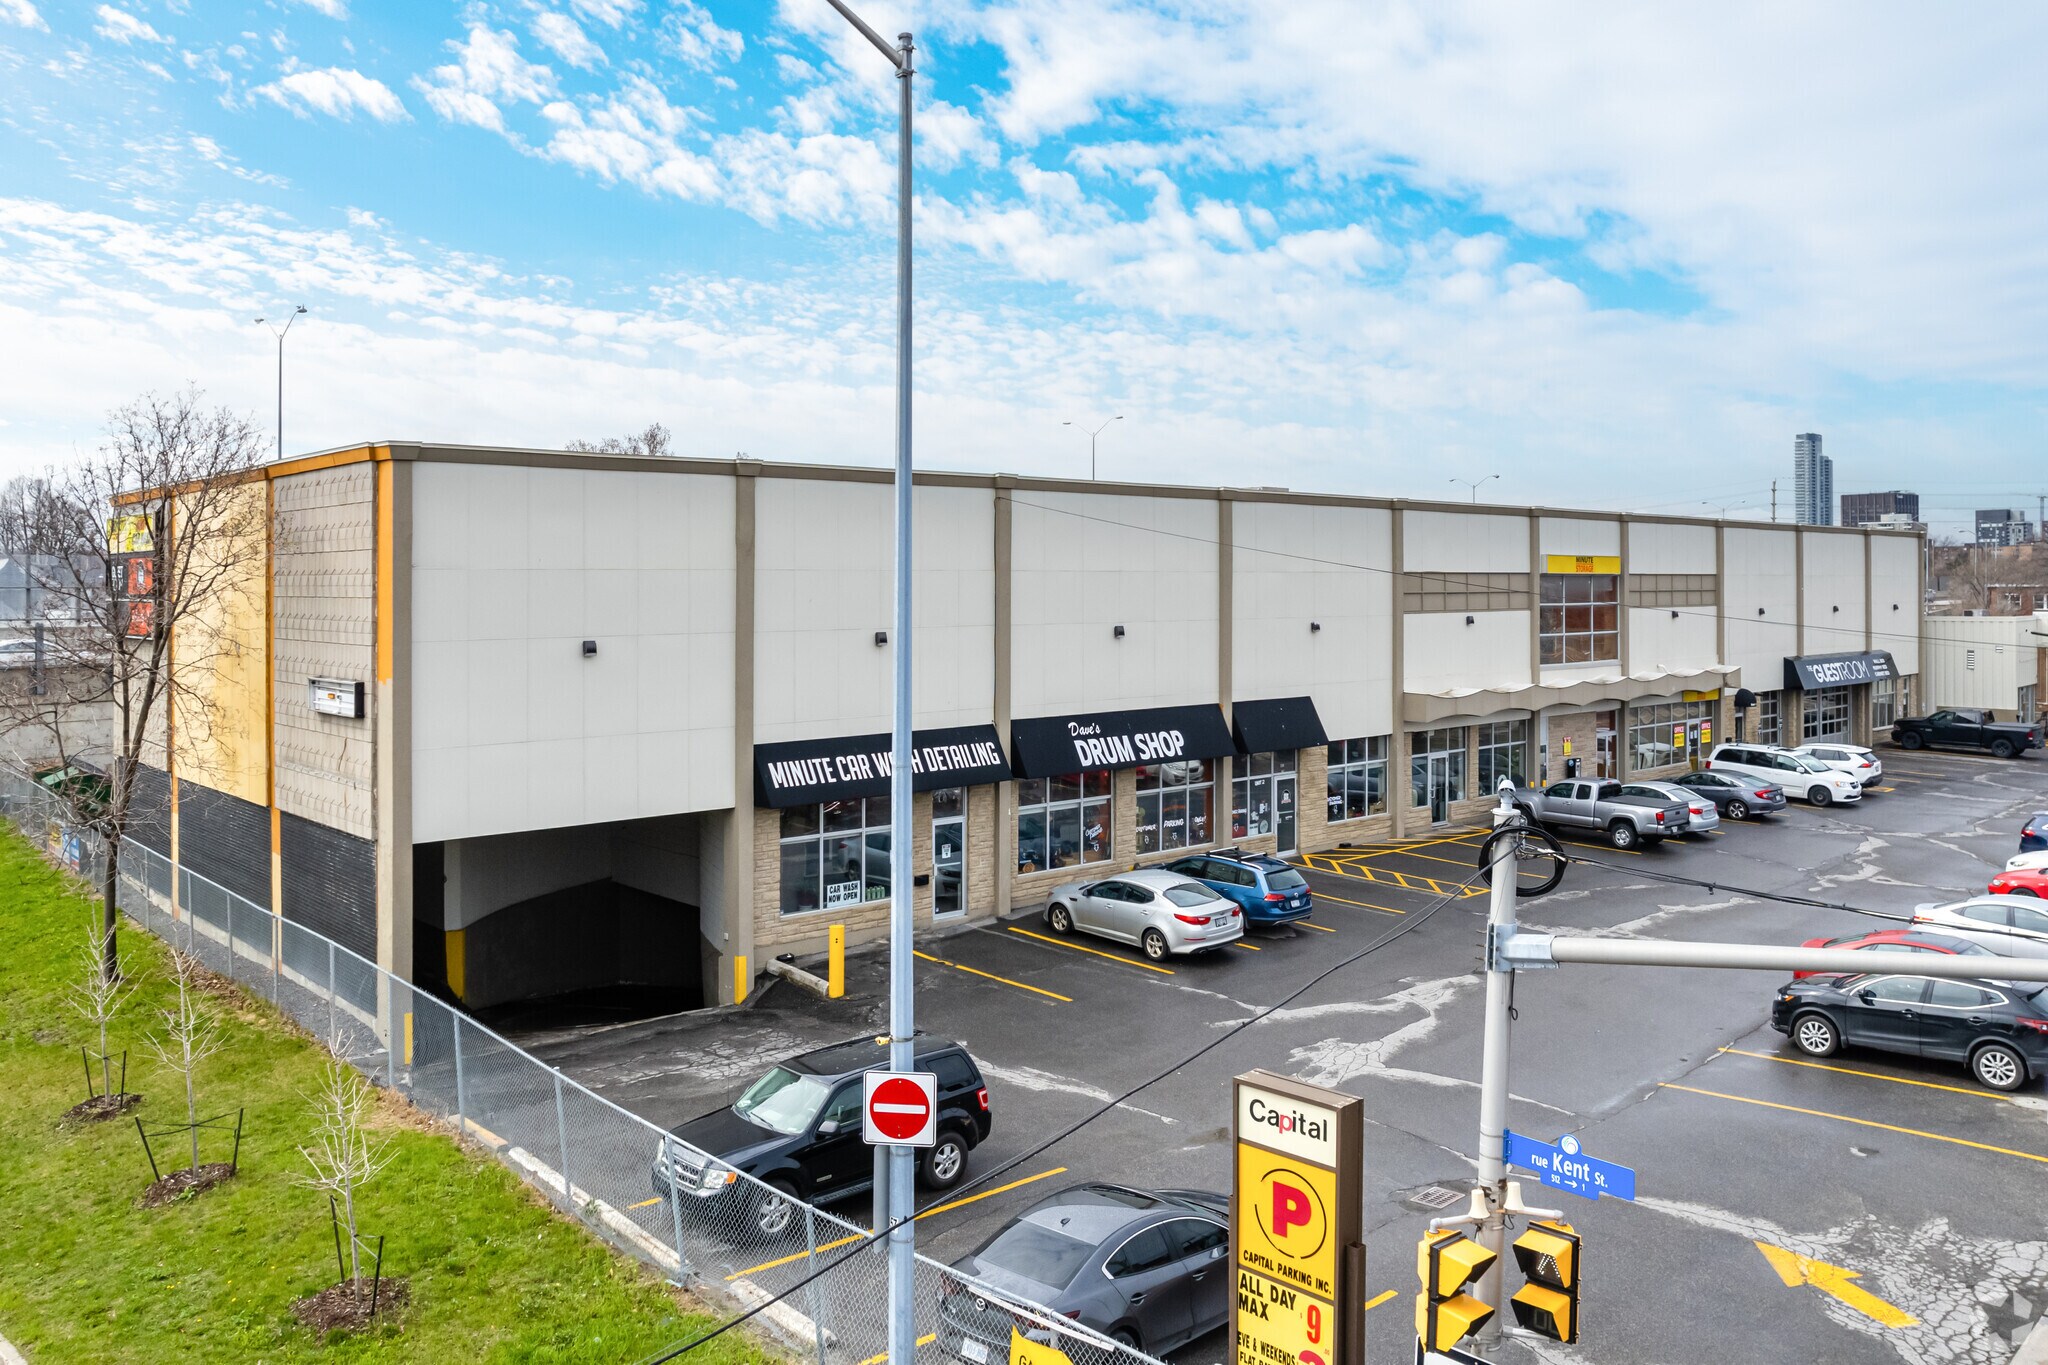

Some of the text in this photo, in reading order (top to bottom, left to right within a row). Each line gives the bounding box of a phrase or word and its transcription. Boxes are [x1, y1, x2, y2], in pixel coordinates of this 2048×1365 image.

[1068, 721, 1101, 737] Dave's
[767, 742, 1001, 789] MINUTE CAR WH DETAILING
[1073, 730, 1185, 767] DRUM SHOP
[829, 891, 858, 903] NOW OPEN
[830, 882, 858, 894] CAR WASH
[1249, 1099, 1327, 1142] Capital
[1531, 1152, 1608, 1188] rue Kent St.
[1551, 1173, 1586, 1191] 512 1
[1272, 1180, 1312, 1239] P
[1243, 1249, 1332, 1295] CAPITAL PARKING INC.
[1239, 1292, 1269, 1321] MAX
[1240, 1272, 1297, 1311] ALL DAY
[1306, 1304, 1322, 1345] 9
[1237, 1331, 1250, 1349] EVE
[1252, 1337, 1257, 1352] &
[1260, 1341, 1296, 1365] WEEKENDS
